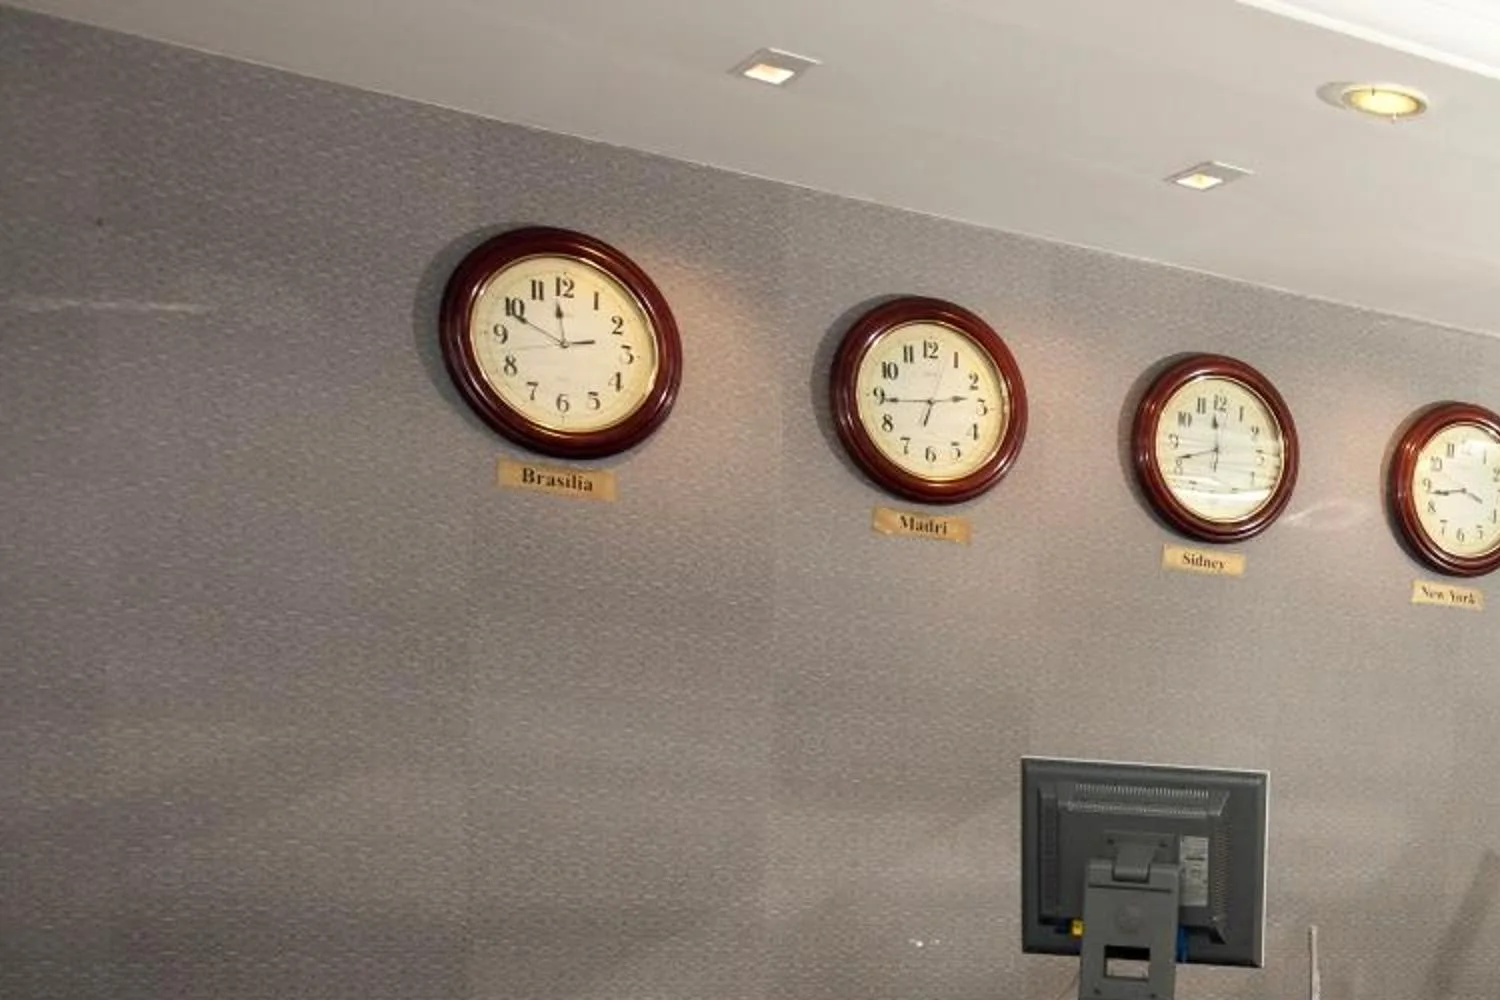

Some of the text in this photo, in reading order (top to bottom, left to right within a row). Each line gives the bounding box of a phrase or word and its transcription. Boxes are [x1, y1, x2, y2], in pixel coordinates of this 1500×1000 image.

[531, 279, 545, 301] 11
[555, 276, 575, 299] 12
[505, 297, 525, 319] 10
[493, 323, 508, 345] 9
[611, 315, 624, 335] 2
[621, 345, 634, 365] 3
[903, 345, 915, 364] 11
[922, 340, 939, 359] 12
[503, 355, 518, 377] 8
[881, 361, 898, 380] 10
[526, 381, 539, 401] 7
[608, 371, 622, 392] 4
[968, 373, 979, 390] 2
[556, 394, 569, 414] 6
[587, 391, 601, 411] 5
[873, 386, 885, 405] 9
[976, 399, 988, 417] 3
[881, 413, 894, 432] 8
[966, 423, 979, 441] 4
[900, 437, 911, 455] 7
[925, 445, 937, 463] 6
[951, 441, 961, 461] 5
[899, 515, 948, 536] Madri
[1183, 552, 1227, 571] Sidney
[1421, 586, 1476, 604] New York
